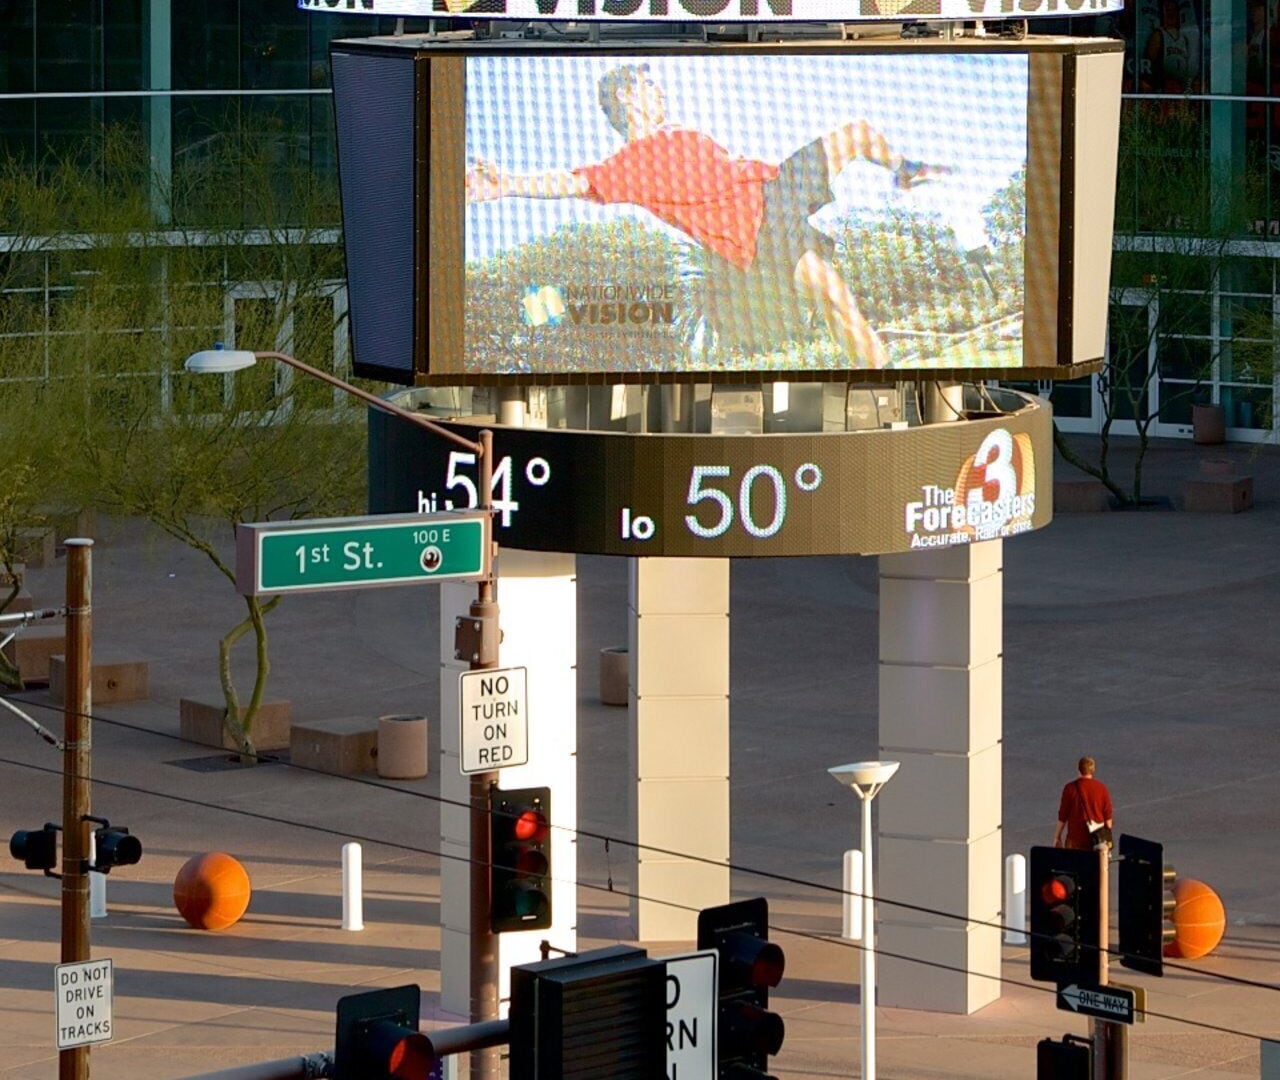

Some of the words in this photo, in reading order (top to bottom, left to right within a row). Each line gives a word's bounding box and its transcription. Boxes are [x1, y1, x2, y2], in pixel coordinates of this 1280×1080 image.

[569, 302, 675, 325] VISION
[922, 484, 955, 506] The
[905, 492, 1036, 532] Forecasters
[621, 508, 655, 539] lo
[413, 530, 438, 544] 100
[442, 529, 451, 543] E
[910, 531, 971, 549] Accurate.
[294, 543, 330, 574] 1st
[342, 541, 385, 571] St.
[480, 676, 509, 697] NO
[472, 700, 518, 721] TURN
[484, 723, 507, 741] ON
[479, 745, 513, 764] RED
[61, 972, 78, 986] DO
[84, 967, 108, 982] NOT
[66, 985, 104, 1003] DRIVE
[1080, 990, 1100, 1008] ONE
[1104, 994, 1126, 1013] WAY
[76, 1005, 94, 1019] ON
[61, 1020, 110, 1040] TRACKS
